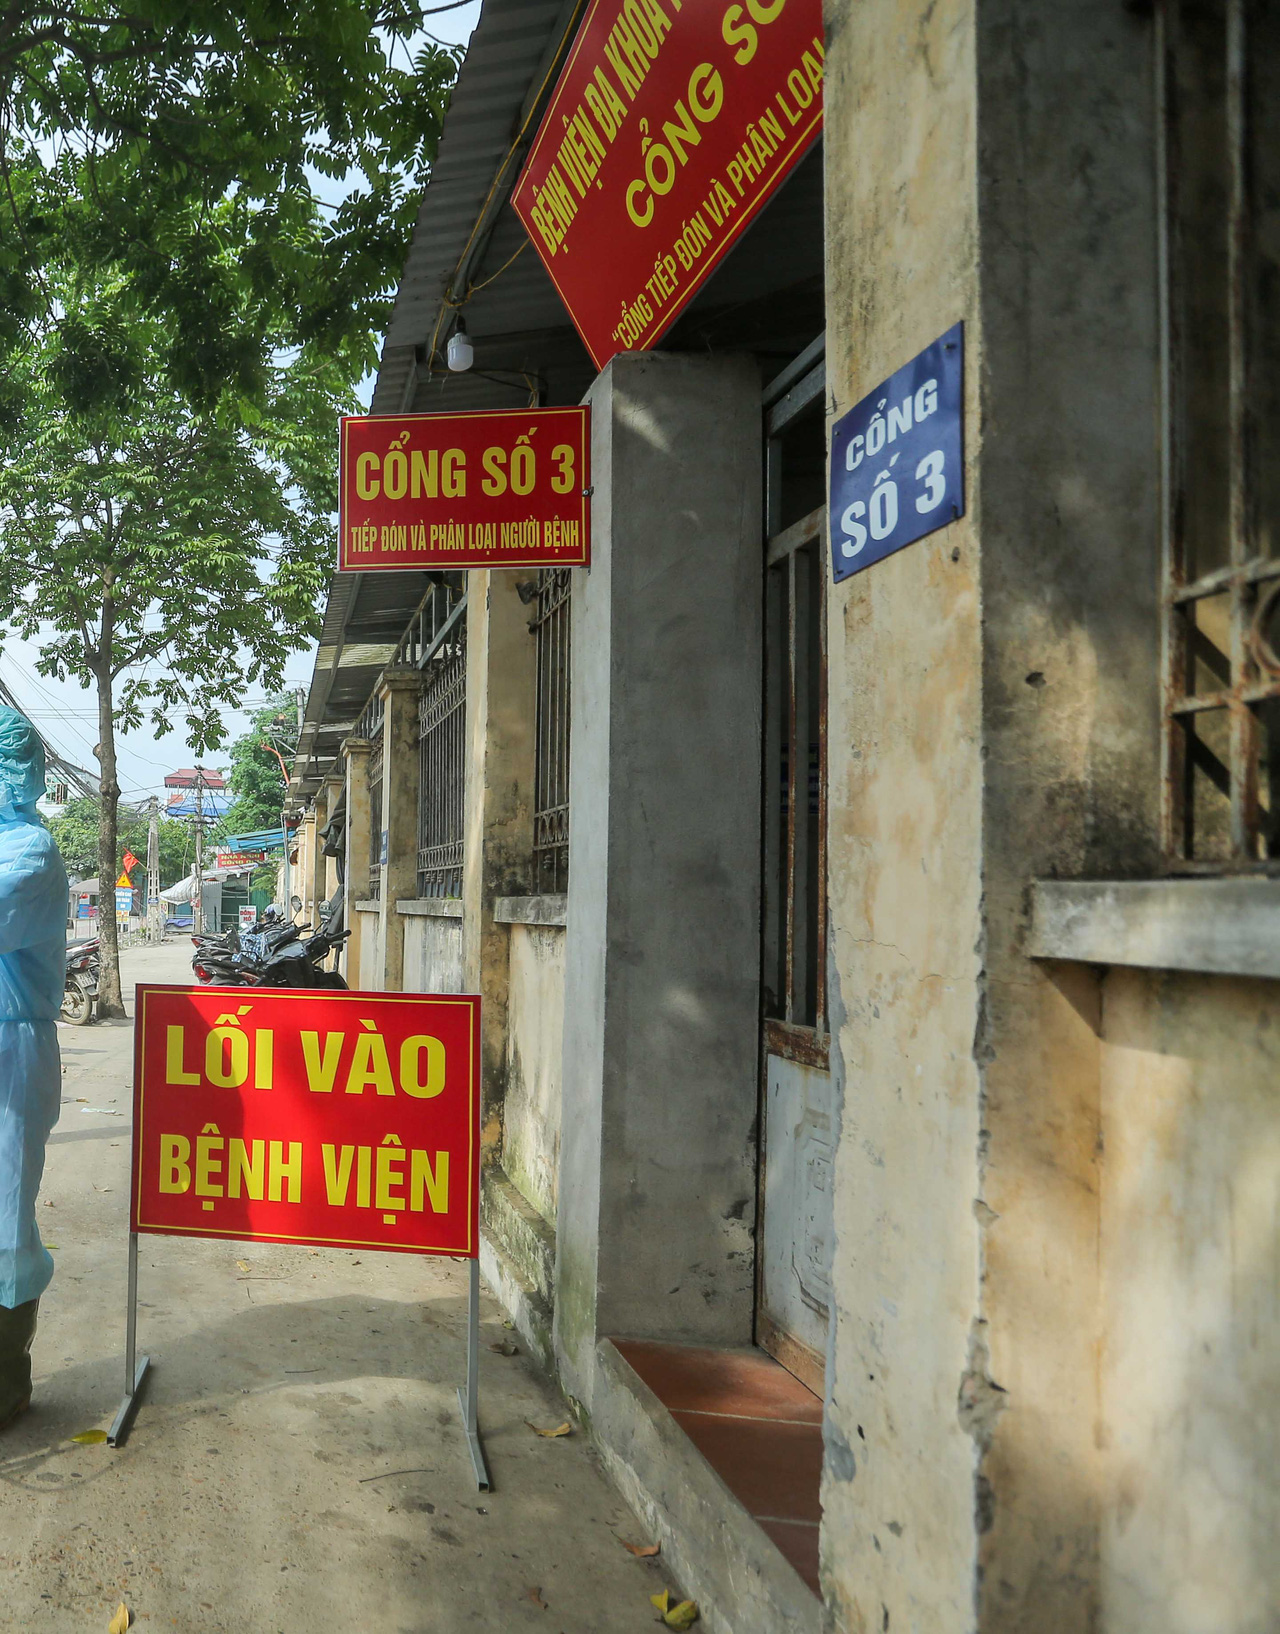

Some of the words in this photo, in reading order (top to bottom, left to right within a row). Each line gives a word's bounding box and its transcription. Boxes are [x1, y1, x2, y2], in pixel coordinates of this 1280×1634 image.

[604, 0, 673, 101] KHOA
[584, 65, 628, 143] ĐA
[625, 62, 724, 227] CỔNG
[556, 104, 607, 199] VIỆN
[530, 163, 579, 257] BỆNH
[645, 252, 678, 307] TIẾP
[673, 211, 713, 271] ĐÓN
[702, 178, 737, 226] VÀ
[726, 107, 786, 197] PHÂN
[356, 430, 466, 500] CỔNG
[481, 427, 538, 496] SỐ
[551, 444, 575, 494] 3
[845, 379, 938, 471] CỔNG
[351, 518, 377, 552] TIẾP
[381, 519, 407, 551] ĐÓN
[410, 519, 427, 550] VÀ
[430, 518, 465, 550] PHÂN
[469, 523, 497, 555] LOẠI
[501, 515, 540, 548] NGƯỜI
[544, 516, 579, 553] BỆNH
[841, 452, 901, 558] SỐ
[915, 450, 946, 514] 3
[166, 1005, 274, 1090] LỐI
[300, 1019, 446, 1099] VÀO
[159, 1123, 302, 1211] BỆNH
[322, 1134, 449, 1225] VIỆN
